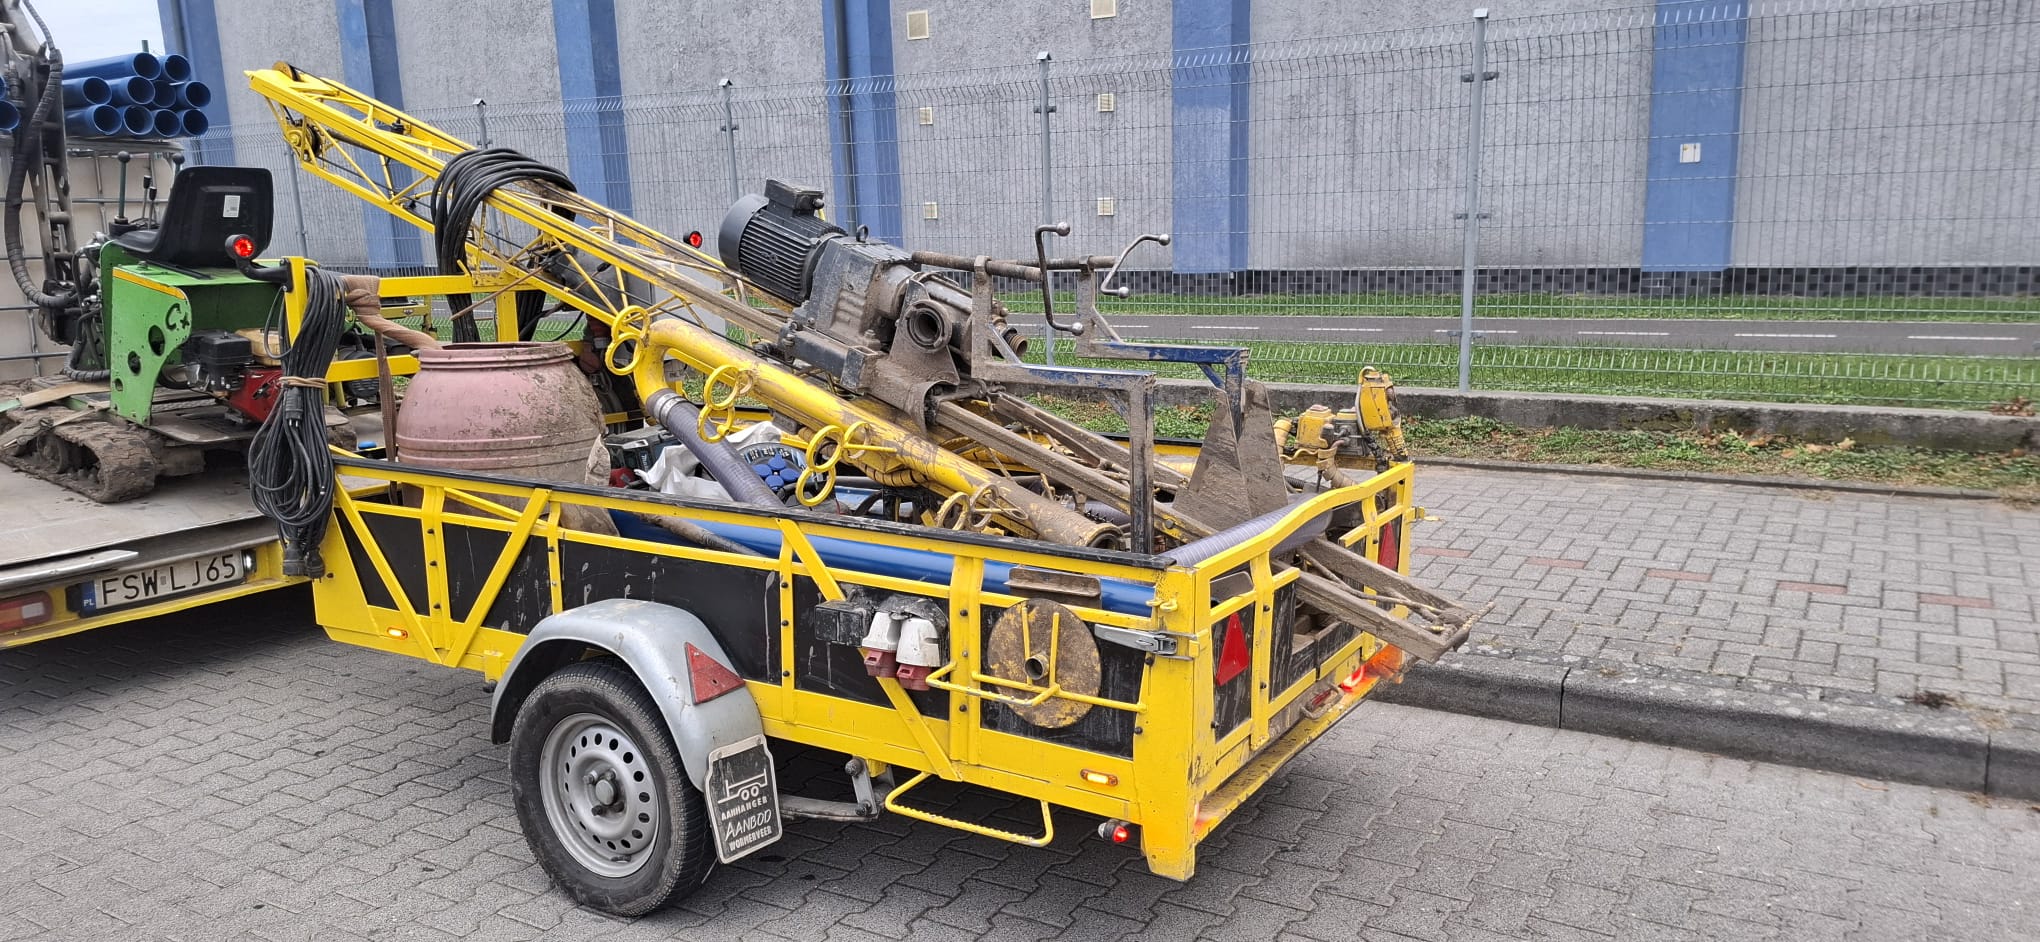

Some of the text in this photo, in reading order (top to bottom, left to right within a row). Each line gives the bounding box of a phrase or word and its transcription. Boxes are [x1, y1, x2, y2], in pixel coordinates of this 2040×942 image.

[102, 554, 236, 605] FSW LJ65
[721, 796, 768, 821] AANHANGER
[725, 808, 772, 841] AANBOD
[729, 825, 772, 851] WORMERVEER
